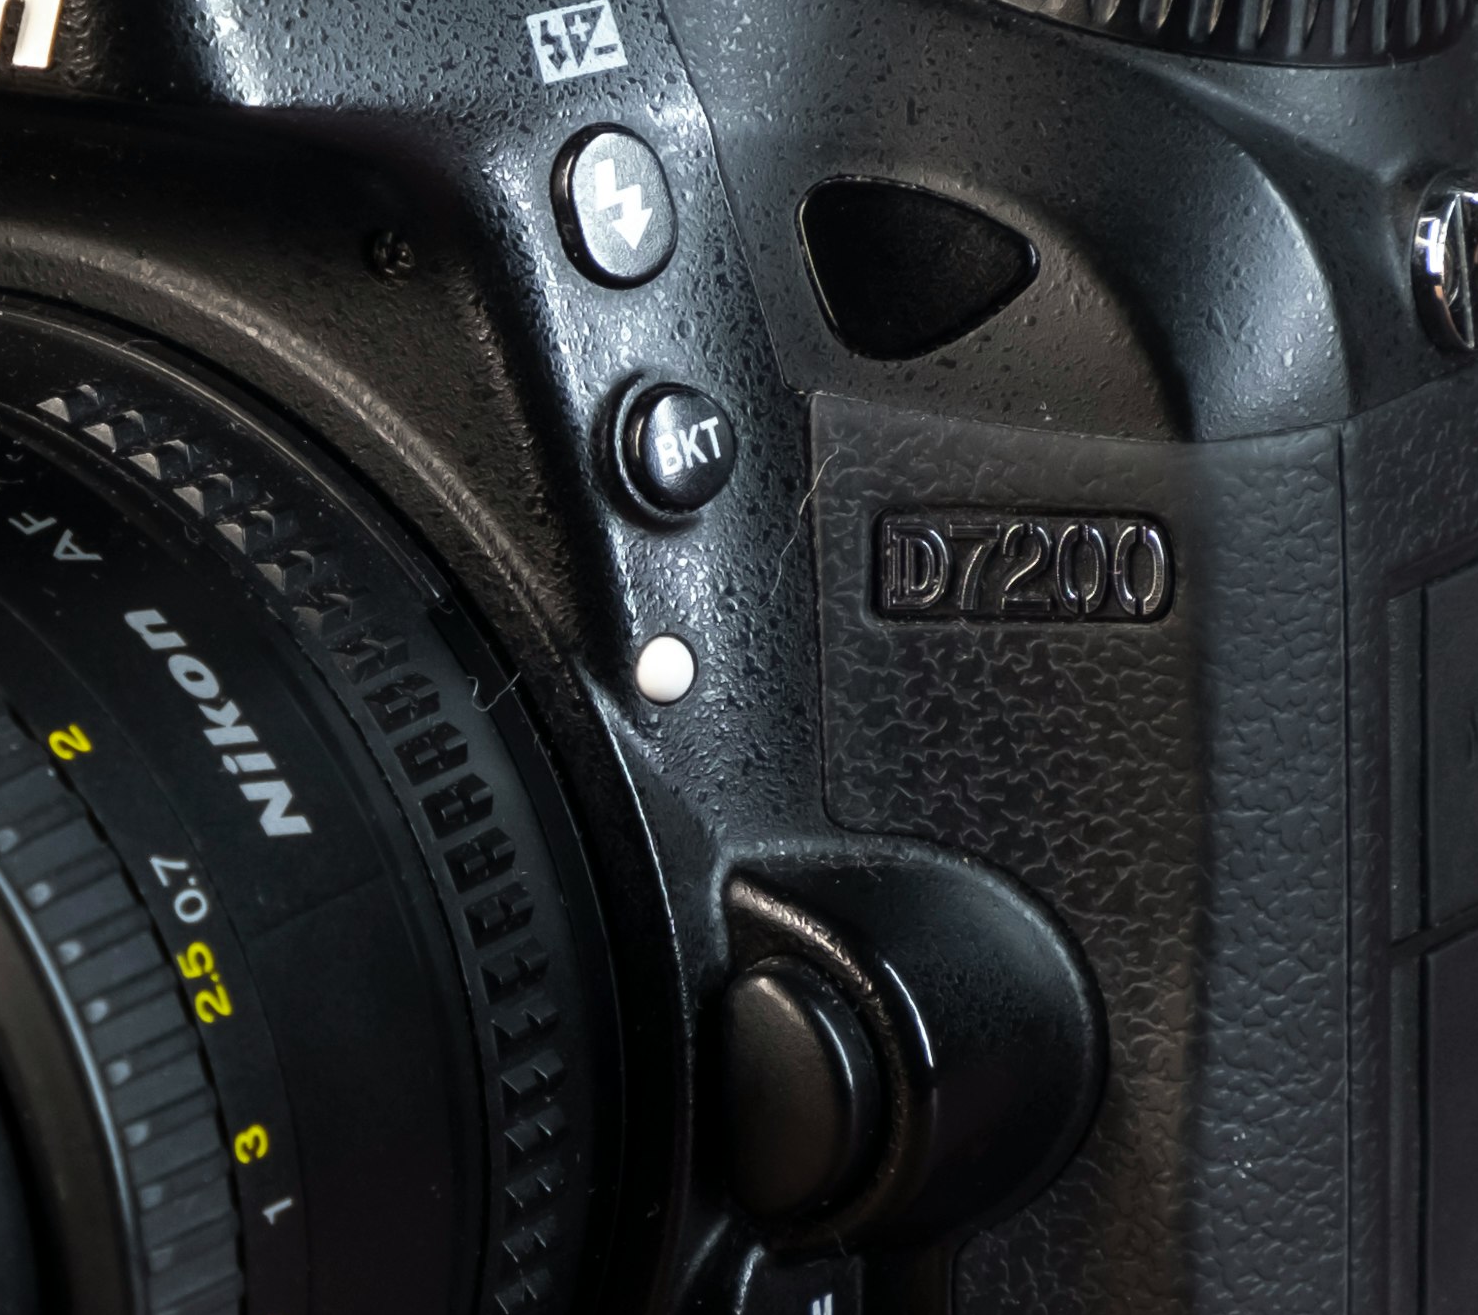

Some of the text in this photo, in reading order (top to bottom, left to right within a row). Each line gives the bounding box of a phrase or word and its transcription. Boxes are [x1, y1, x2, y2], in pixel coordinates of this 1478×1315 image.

[654, 416, 721, 478] BKT
[8, 509, 104, 563] AF
[882, 521, 1166, 616] D7200
[48, 723, 94, 762] 2
[123, 607, 314, 838] Nikon
[149, 854, 209, 923] 0.7
[176, 941, 233, 1024] 2.5
[234, 1124, 270, 1165] 3
[261, 1197, 293, 1226] 1
